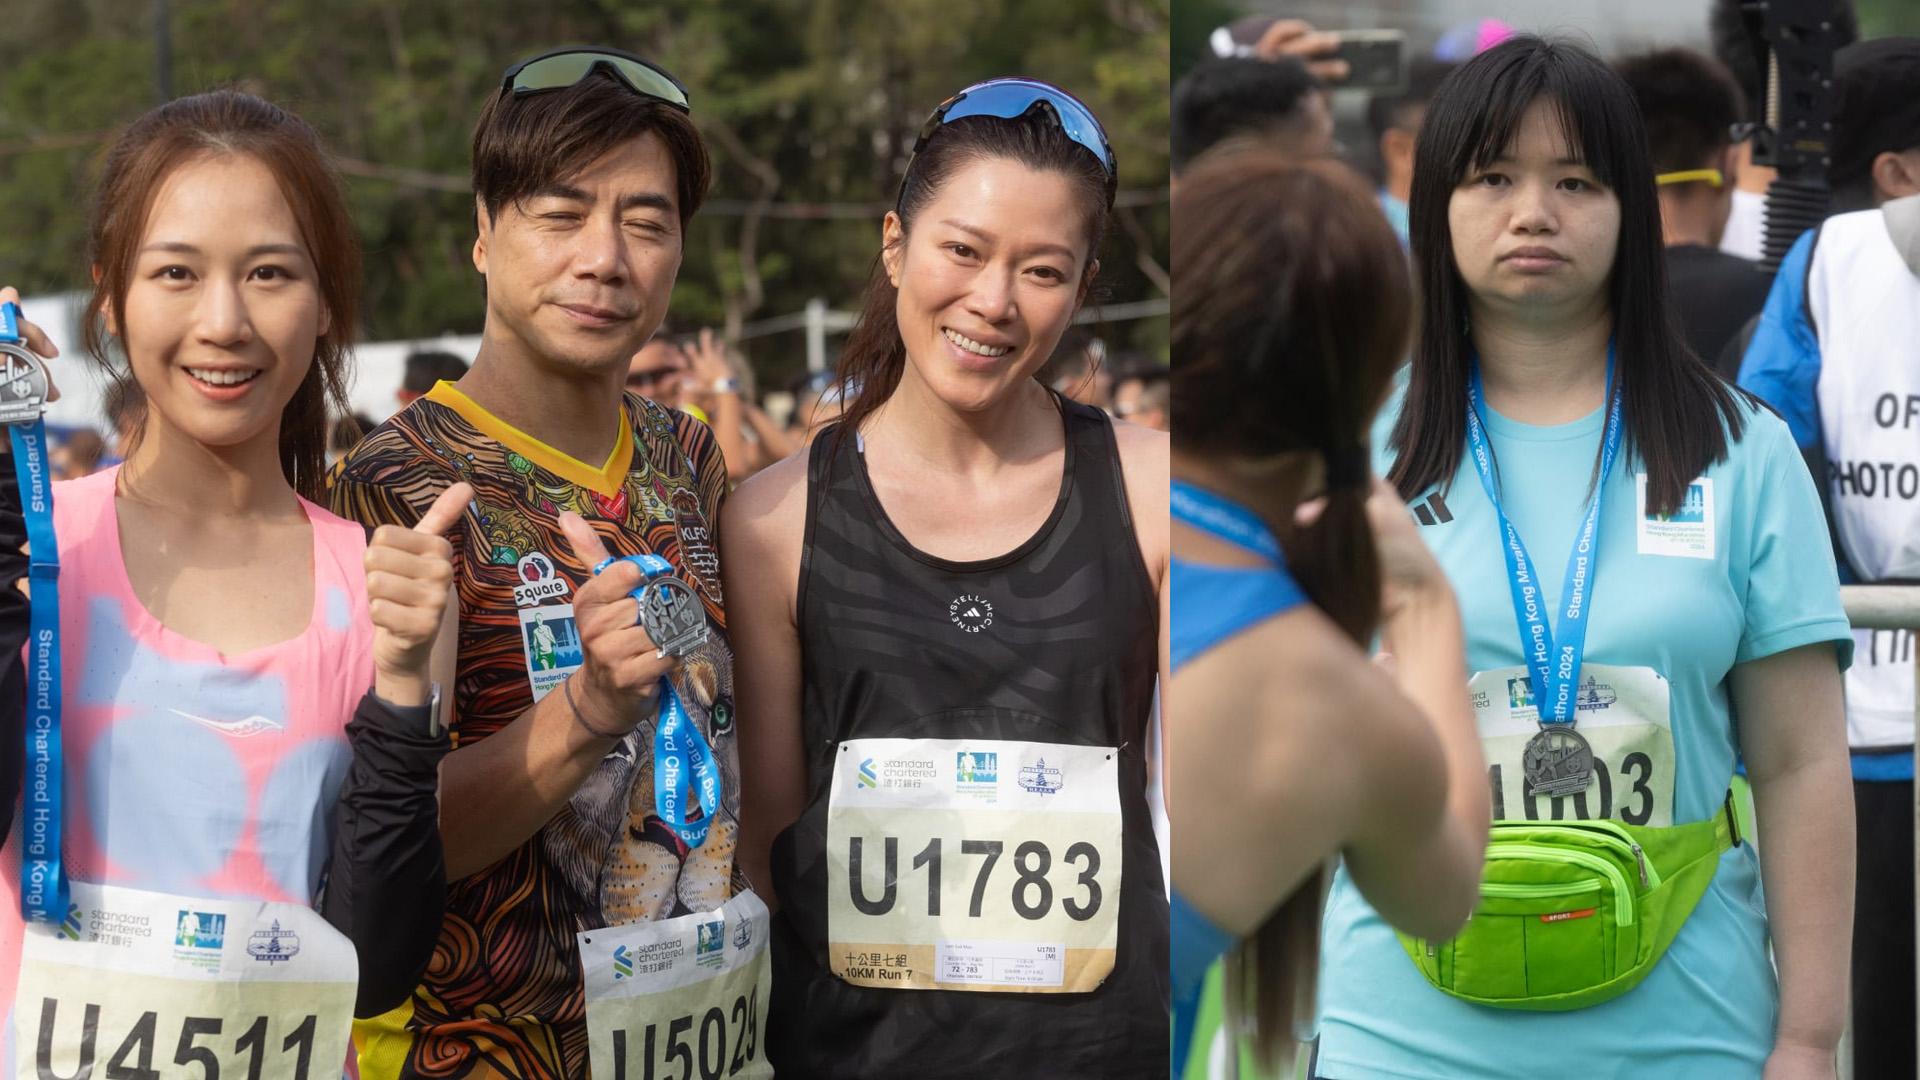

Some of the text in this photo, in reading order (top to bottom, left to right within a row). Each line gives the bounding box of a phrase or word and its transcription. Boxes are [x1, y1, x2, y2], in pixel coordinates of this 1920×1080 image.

[22, 434, 45, 514] Standard
[680, 527, 708, 541] KLFC
[515, 582, 563, 601] square
[1523, 586, 1540, 622] Kong
[1567, 556, 1587, 619] Standard
[1531, 624, 1548, 662] Hong
[36, 629, 53, 709] Standard
[1558, 646, 1574, 679] 2024
[34, 715, 52, 802] Chartered
[883, 759, 934, 769] standard
[883, 768, 937, 778] chartered
[664, 756, 680, 824] Chartere
[29, 808, 50, 854] Hong
[26, 860, 48, 906] Kong
[849, 837, 1103, 922] U1783
[90, 909, 150, 926] standard
[90, 919, 152, 937] chartered
[1549, 912, 1571, 921] SPORT
[638, 938, 682, 954] standard
[638, 948, 684, 963] chartered
[845, 953, 908, 968] 十公里七組
[845, 967, 913, 981] 10KM Run 7
[36, 996, 318, 1080] U4511
[612, 984, 758, 1080] U5029
